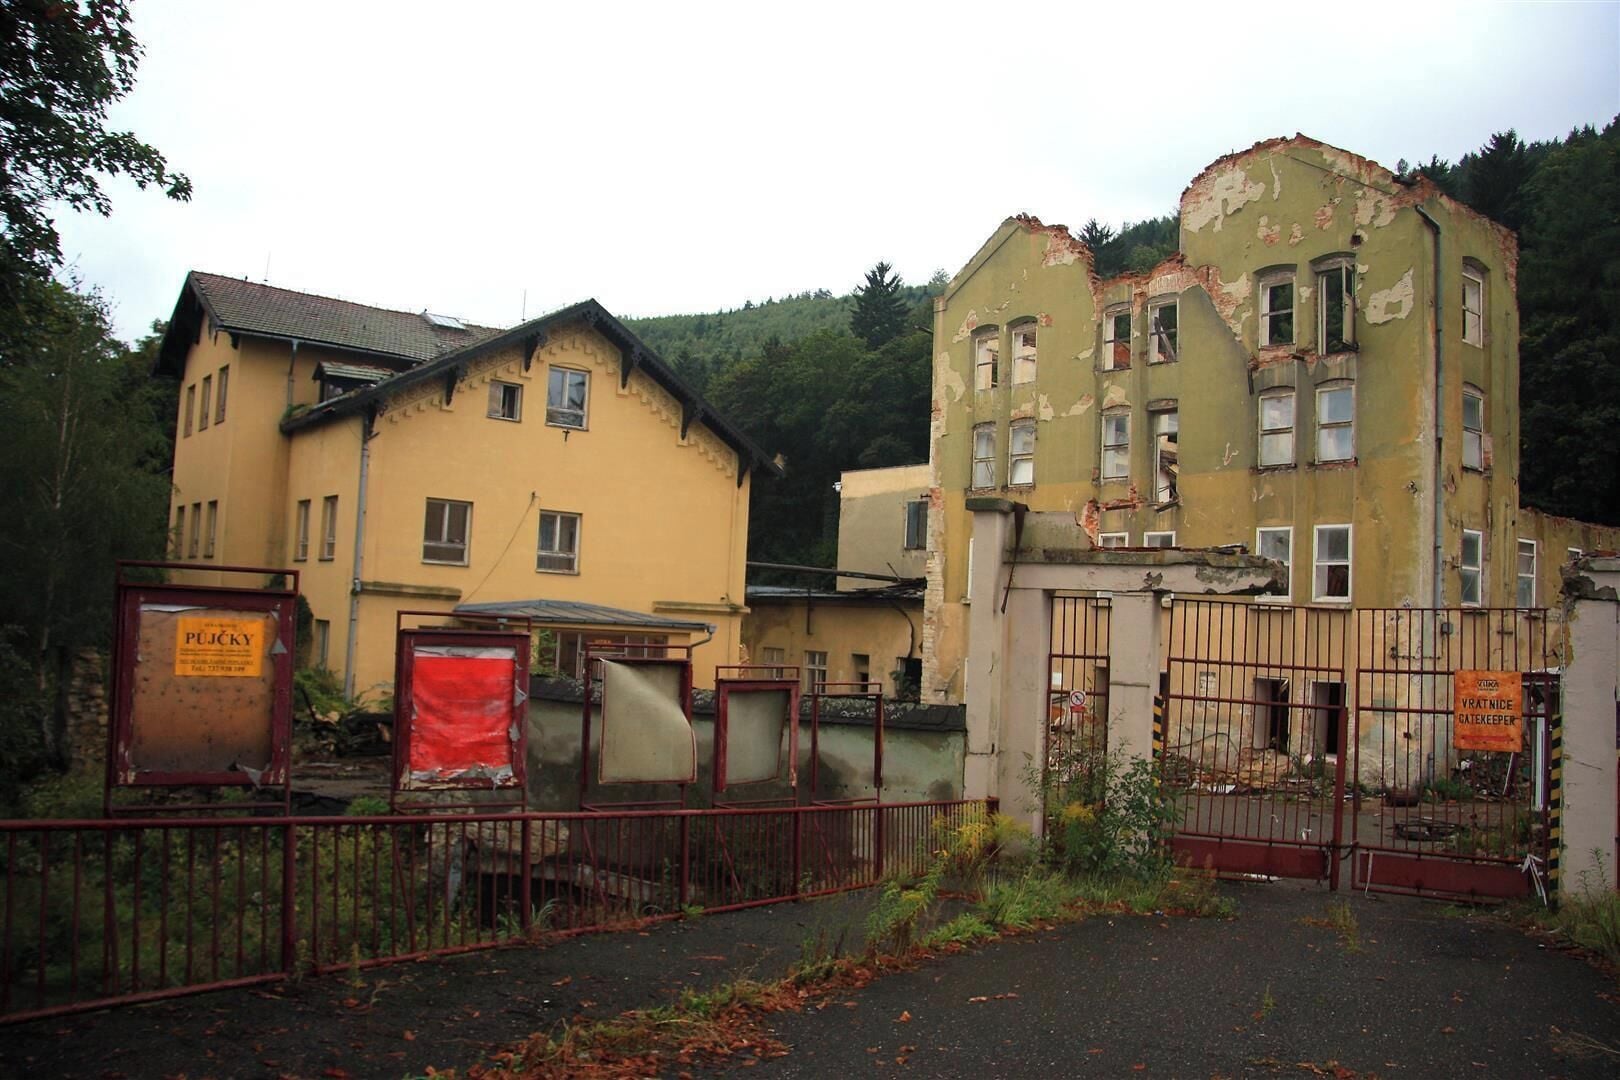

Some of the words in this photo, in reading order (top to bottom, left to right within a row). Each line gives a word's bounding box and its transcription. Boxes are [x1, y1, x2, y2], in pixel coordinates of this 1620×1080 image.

[186, 629, 254, 646] PŮJČKY
[1462, 698, 1513, 710] VRATNICE
[1459, 713, 1515, 726] GATEKEEPER
